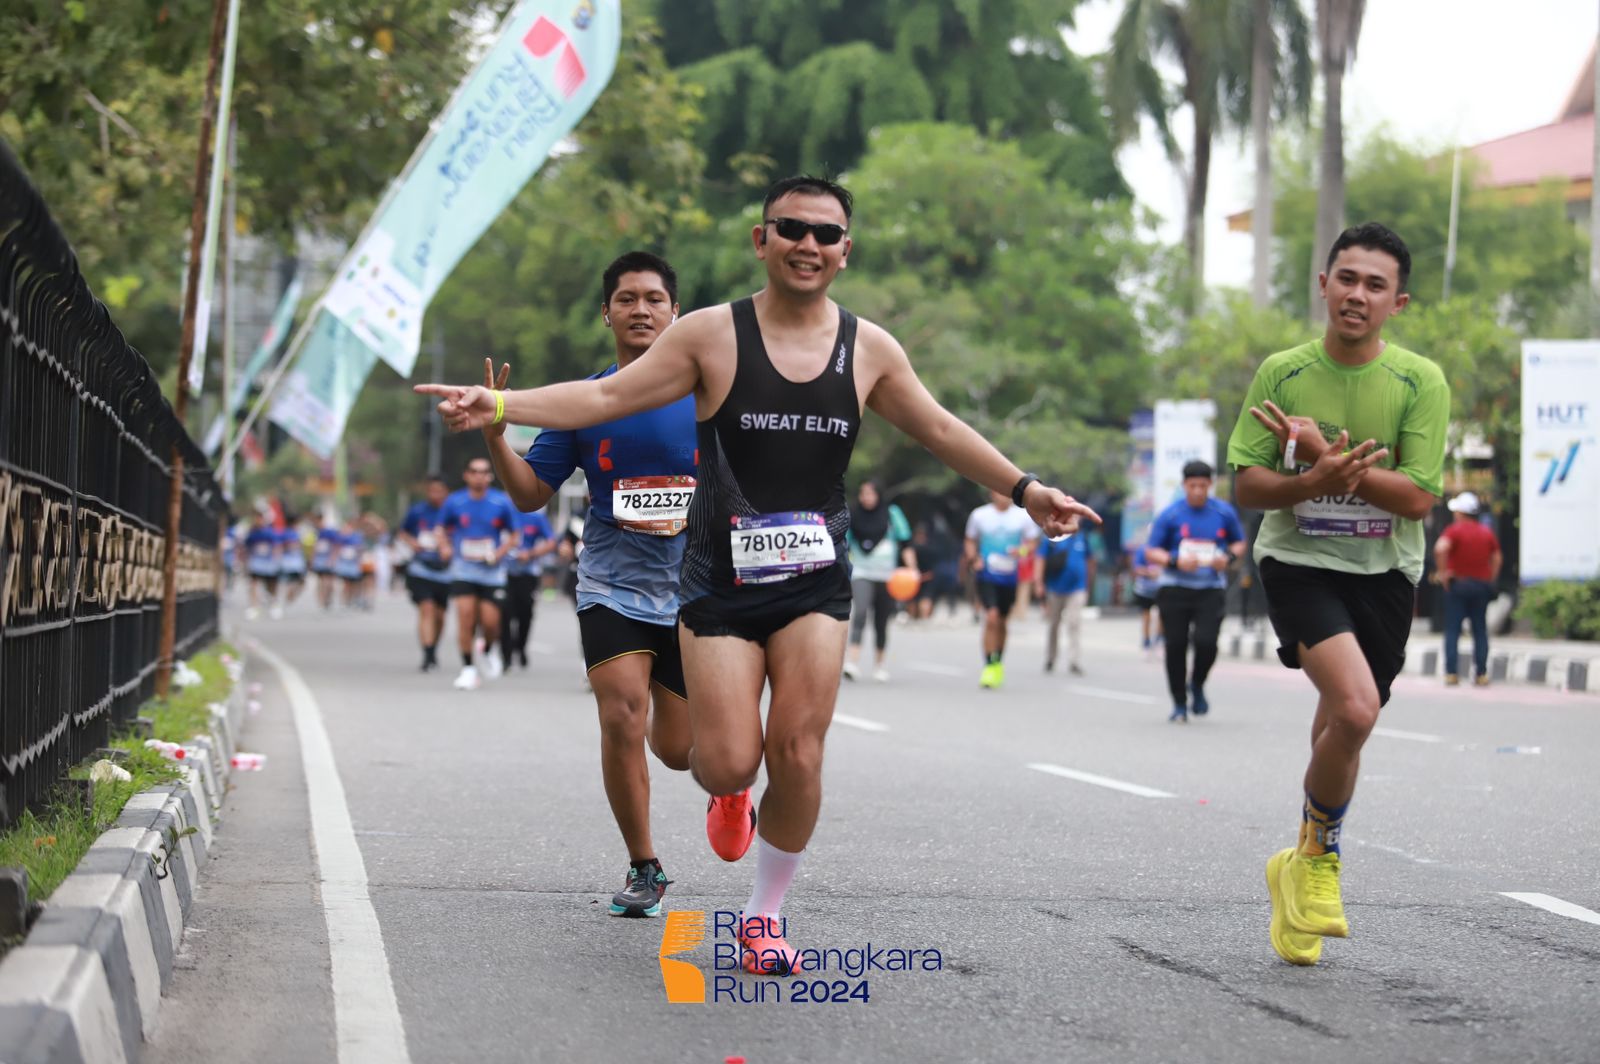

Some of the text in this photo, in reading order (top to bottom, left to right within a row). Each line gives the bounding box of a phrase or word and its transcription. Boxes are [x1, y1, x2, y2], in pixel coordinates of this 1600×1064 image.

[835, 343, 847, 375] soar
[1536, 403, 1588, 425] HUT
[740, 413, 849, 438] SWEAT ELITE
[621, 492, 693, 509] 7822327
[740, 531, 824, 553] 7810244
